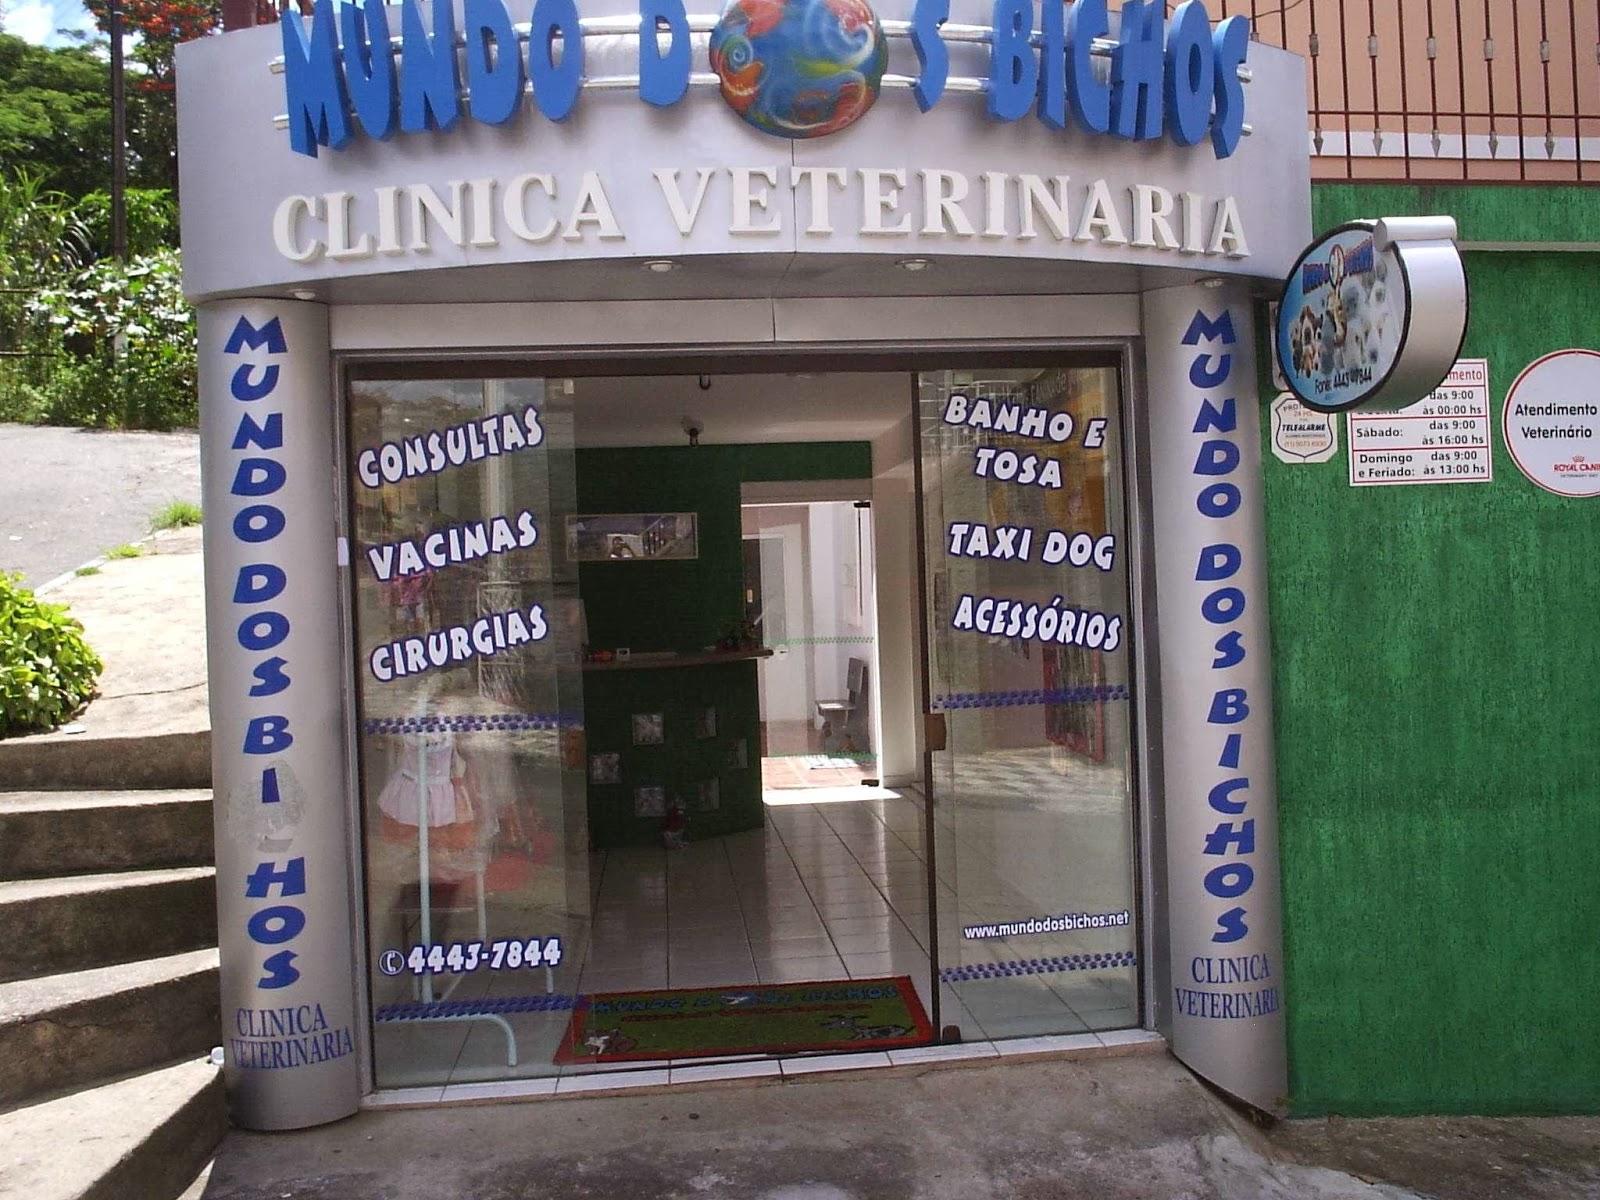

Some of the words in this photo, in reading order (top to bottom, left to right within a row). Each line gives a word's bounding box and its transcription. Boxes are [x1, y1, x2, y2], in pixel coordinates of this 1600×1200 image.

[281, 0, 584, 158] MUNDO
[990, 0, 1250, 160] BICHOS
[272, 171, 626, 263] CLINICA
[652, 166, 1251, 259] VETERINARIA
[1181, 309, 1242, 518] MUNDO
[1437, 405, 1466, 415] 00:00
[1470, 405, 1482, 414] hs
[1451, 390, 1474, 400] 9:00
[1515, 403, 1598, 416] Atendimento
[224, 315, 288, 543] MUNDO
[944, 394, 1074, 443] BANHO
[1083, 418, 1107, 448] E
[1356, 428, 1403, 438] Sábado:
[1429, 420, 1449, 430] das
[1452, 420, 1476, 429] 9:00
[1438, 436, 1468, 445] 16:00
[1471, 435, 1483, 444] hs
[1521, 424, 1593, 438] Veterinário
[357, 404, 546, 489] CONSULTAS
[1360, 453, 1413, 464] Domingo
[1431, 451, 1450, 461] das
[1454, 451, 1477, 460] 9:00
[974, 447, 1063, 490] TOSA
[1368, 467, 1415, 477] Feriado:
[1440, 465, 1469, 474] 13:00
[1472, 464, 1485, 473] hs
[367, 510, 540, 582] VACINAS
[948, 523, 1033, 561] TAXI
[1042, 530, 1116, 572] DOG
[952, 595, 1123, 653] ACESSÓRIOS
[1195, 543, 1246, 669] DOS
[232, 563, 291, 697] DOS
[370, 602, 550, 683] CIRURGIAS
[1202, 688, 1256, 943] BICHOS
[242, 715, 306, 990] BIHOS
[963, 910, 1131, 941] www.mundodosbichos.net
[406, 937, 563, 975] 4443-7844
[1191, 953, 1272, 984] CLINICA
[236, 1003, 328, 1038] CLINICA
[1175, 985, 1281, 1019] VETERINARIA
[230, 1027, 354, 1069] VETERINARIA
